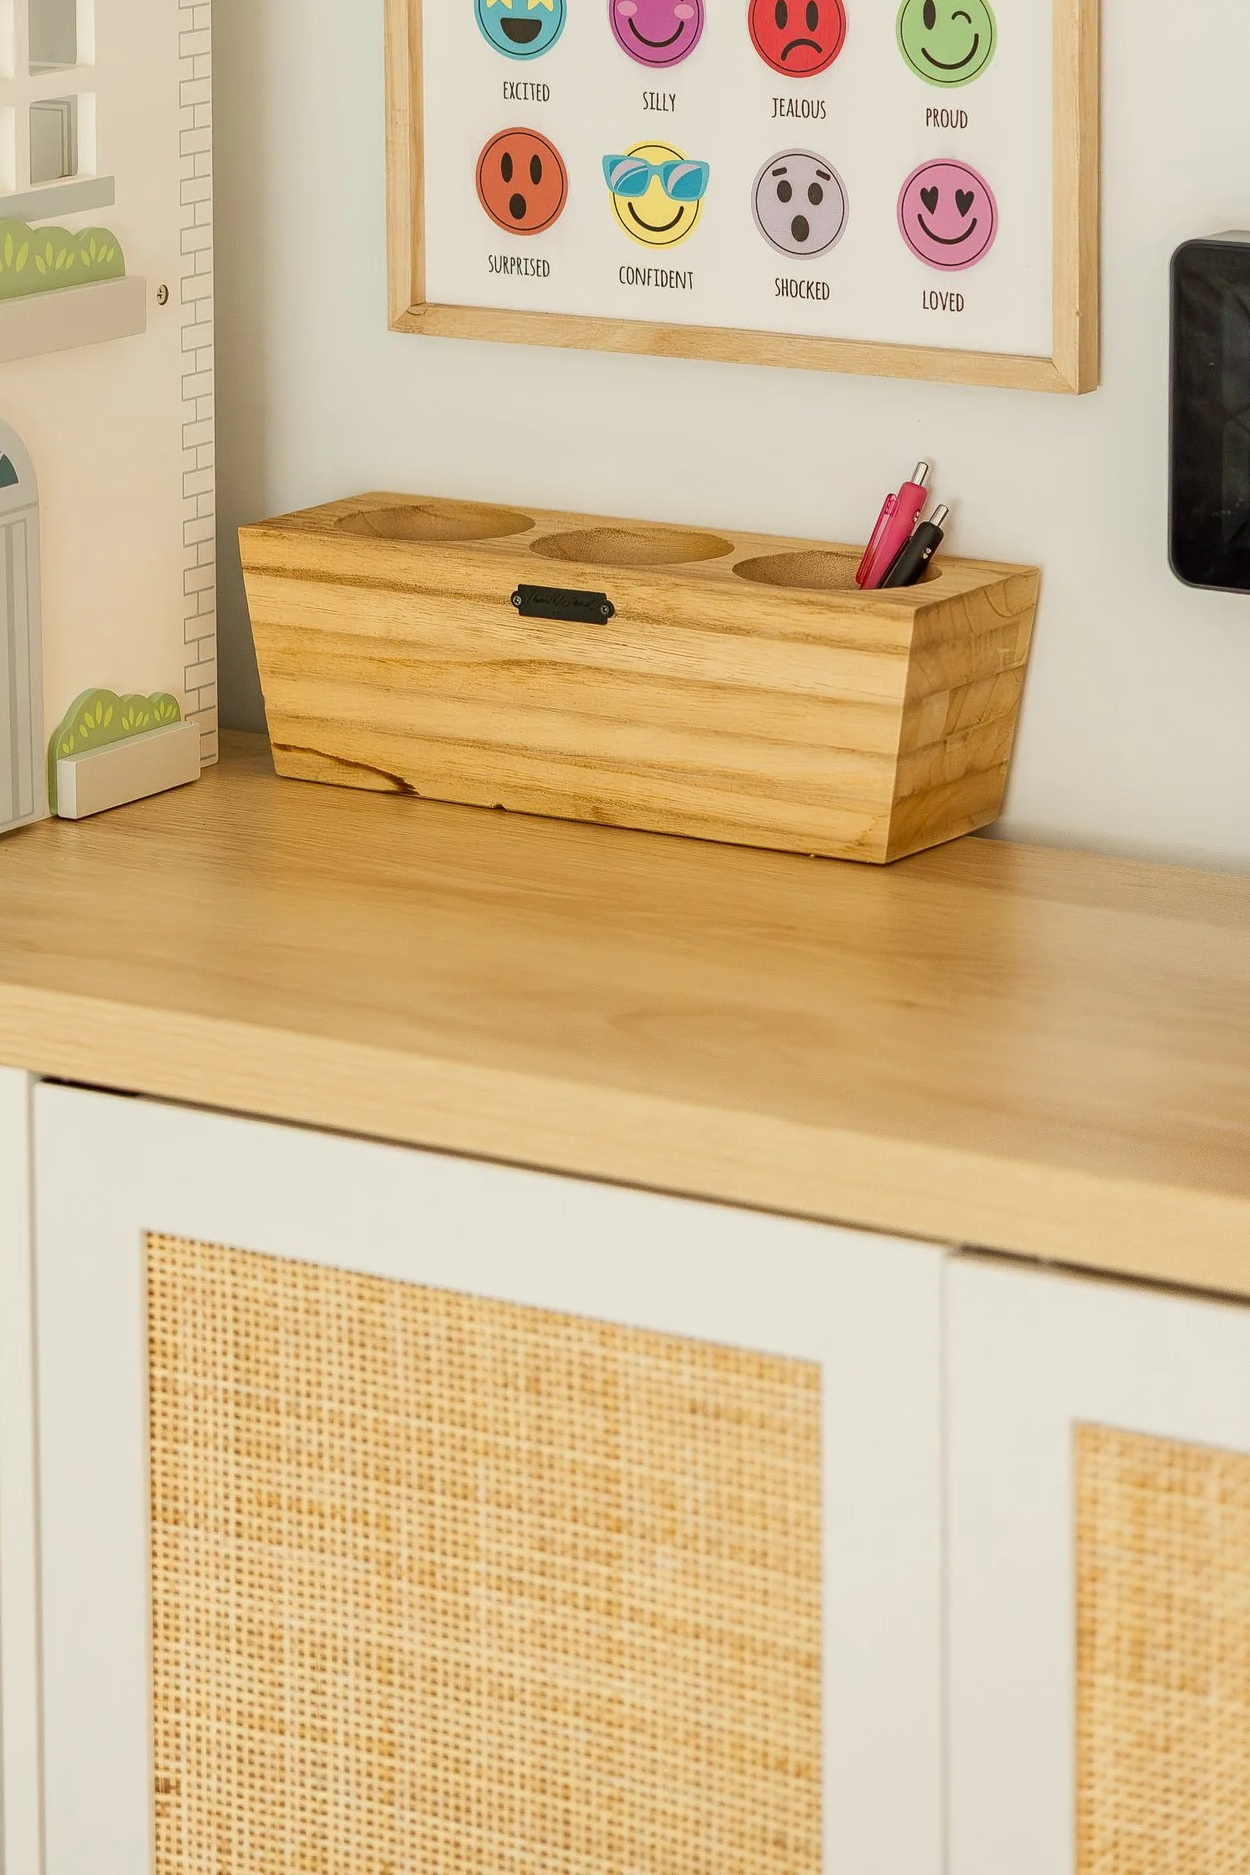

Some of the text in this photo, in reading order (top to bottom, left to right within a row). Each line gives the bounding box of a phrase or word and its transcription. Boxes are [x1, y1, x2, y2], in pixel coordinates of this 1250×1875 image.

[503, 81, 550, 102] EXCITED
[642, 91, 676, 112] SILLY
[771, 97, 827, 120] JEALOUS
[926, 107, 968, 129] PROUD
[488, 254, 550, 278] SURPRISED
[619, 265, 694, 290] CONFIDENT
[774, 277, 830, 301] SHOCKED
[922, 290, 965, 312] LOVED
